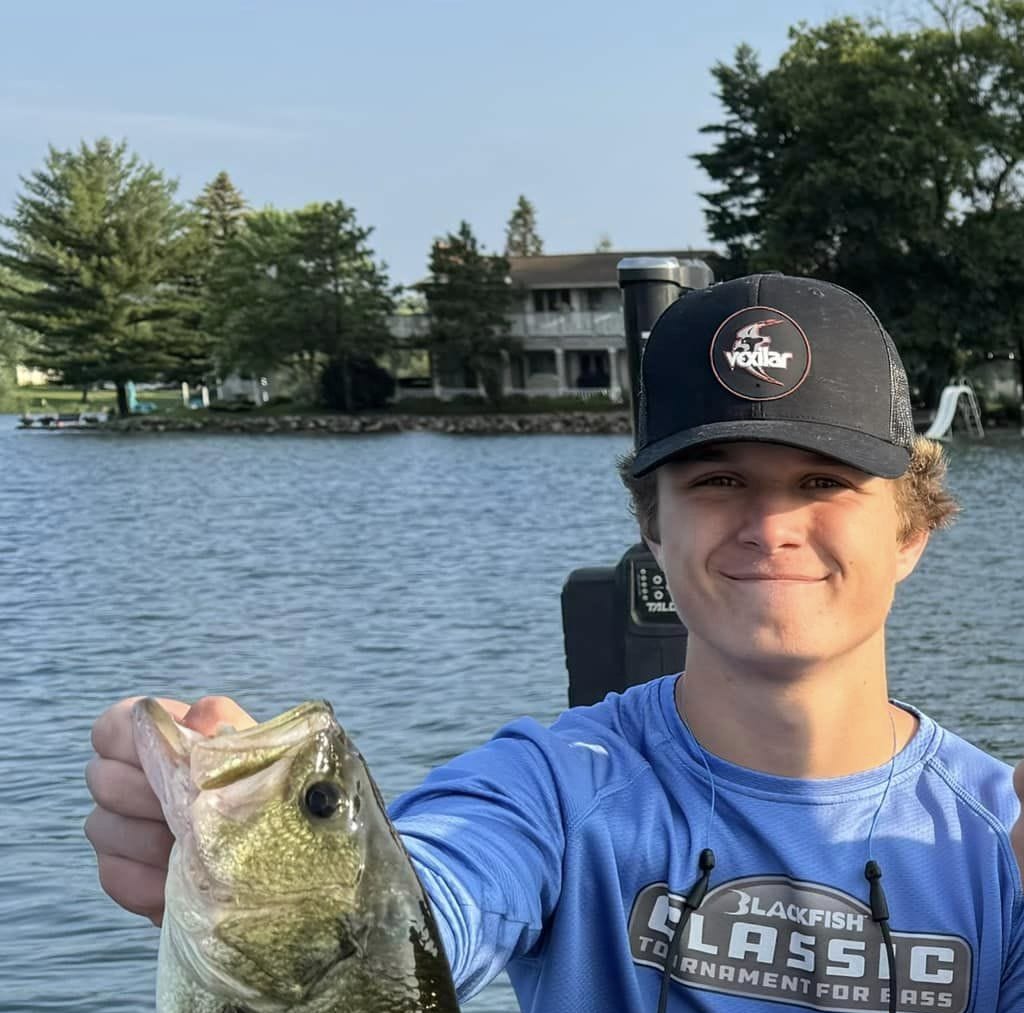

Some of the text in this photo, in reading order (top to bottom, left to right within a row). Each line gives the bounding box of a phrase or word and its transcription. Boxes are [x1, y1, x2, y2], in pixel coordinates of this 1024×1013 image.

[645, 602, 678, 612] TALO
[724, 889, 865, 932] BLACKFISH
[639, 935, 811, 995] TORNAMENT
[816, 983, 870, 1003] FOR
